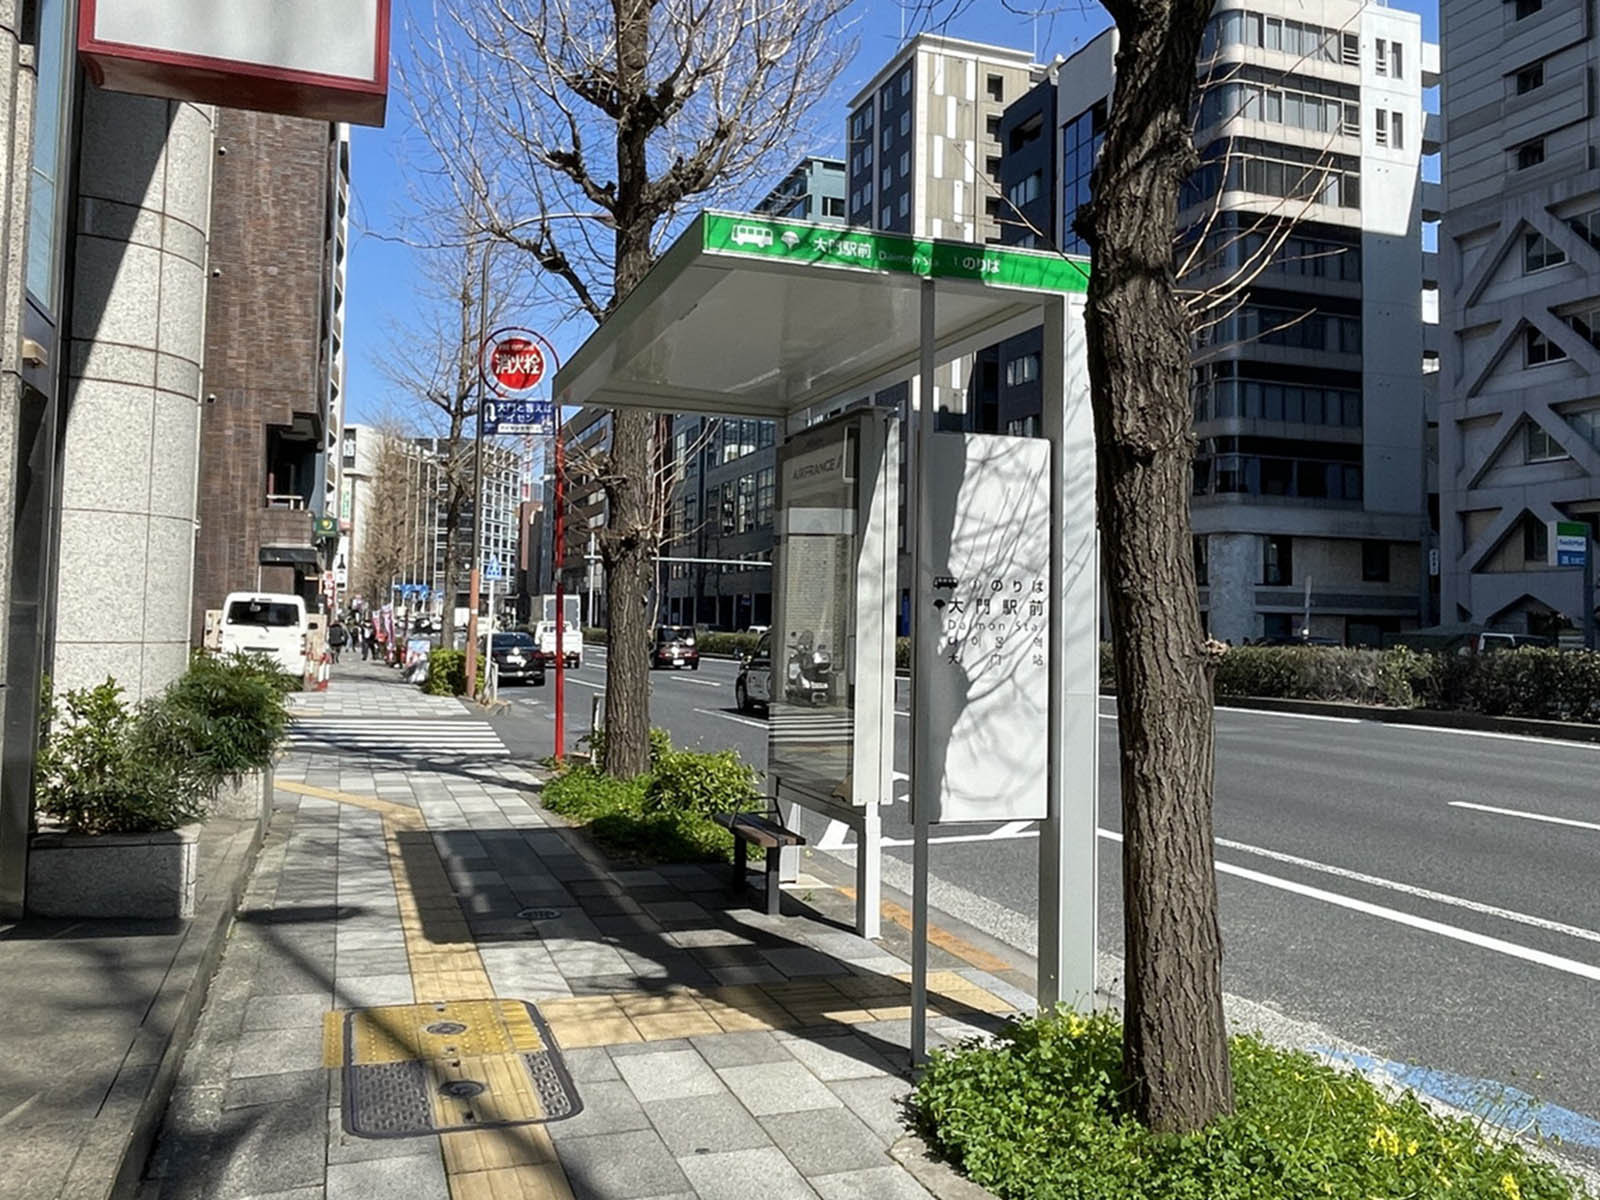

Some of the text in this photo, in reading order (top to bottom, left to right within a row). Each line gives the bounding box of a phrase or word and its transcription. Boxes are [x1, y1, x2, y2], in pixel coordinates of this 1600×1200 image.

[495, 353, 541, 375] 消火栓
[947, 597, 1044, 616] 大門駅前
[947, 619, 1006, 631] Damon
